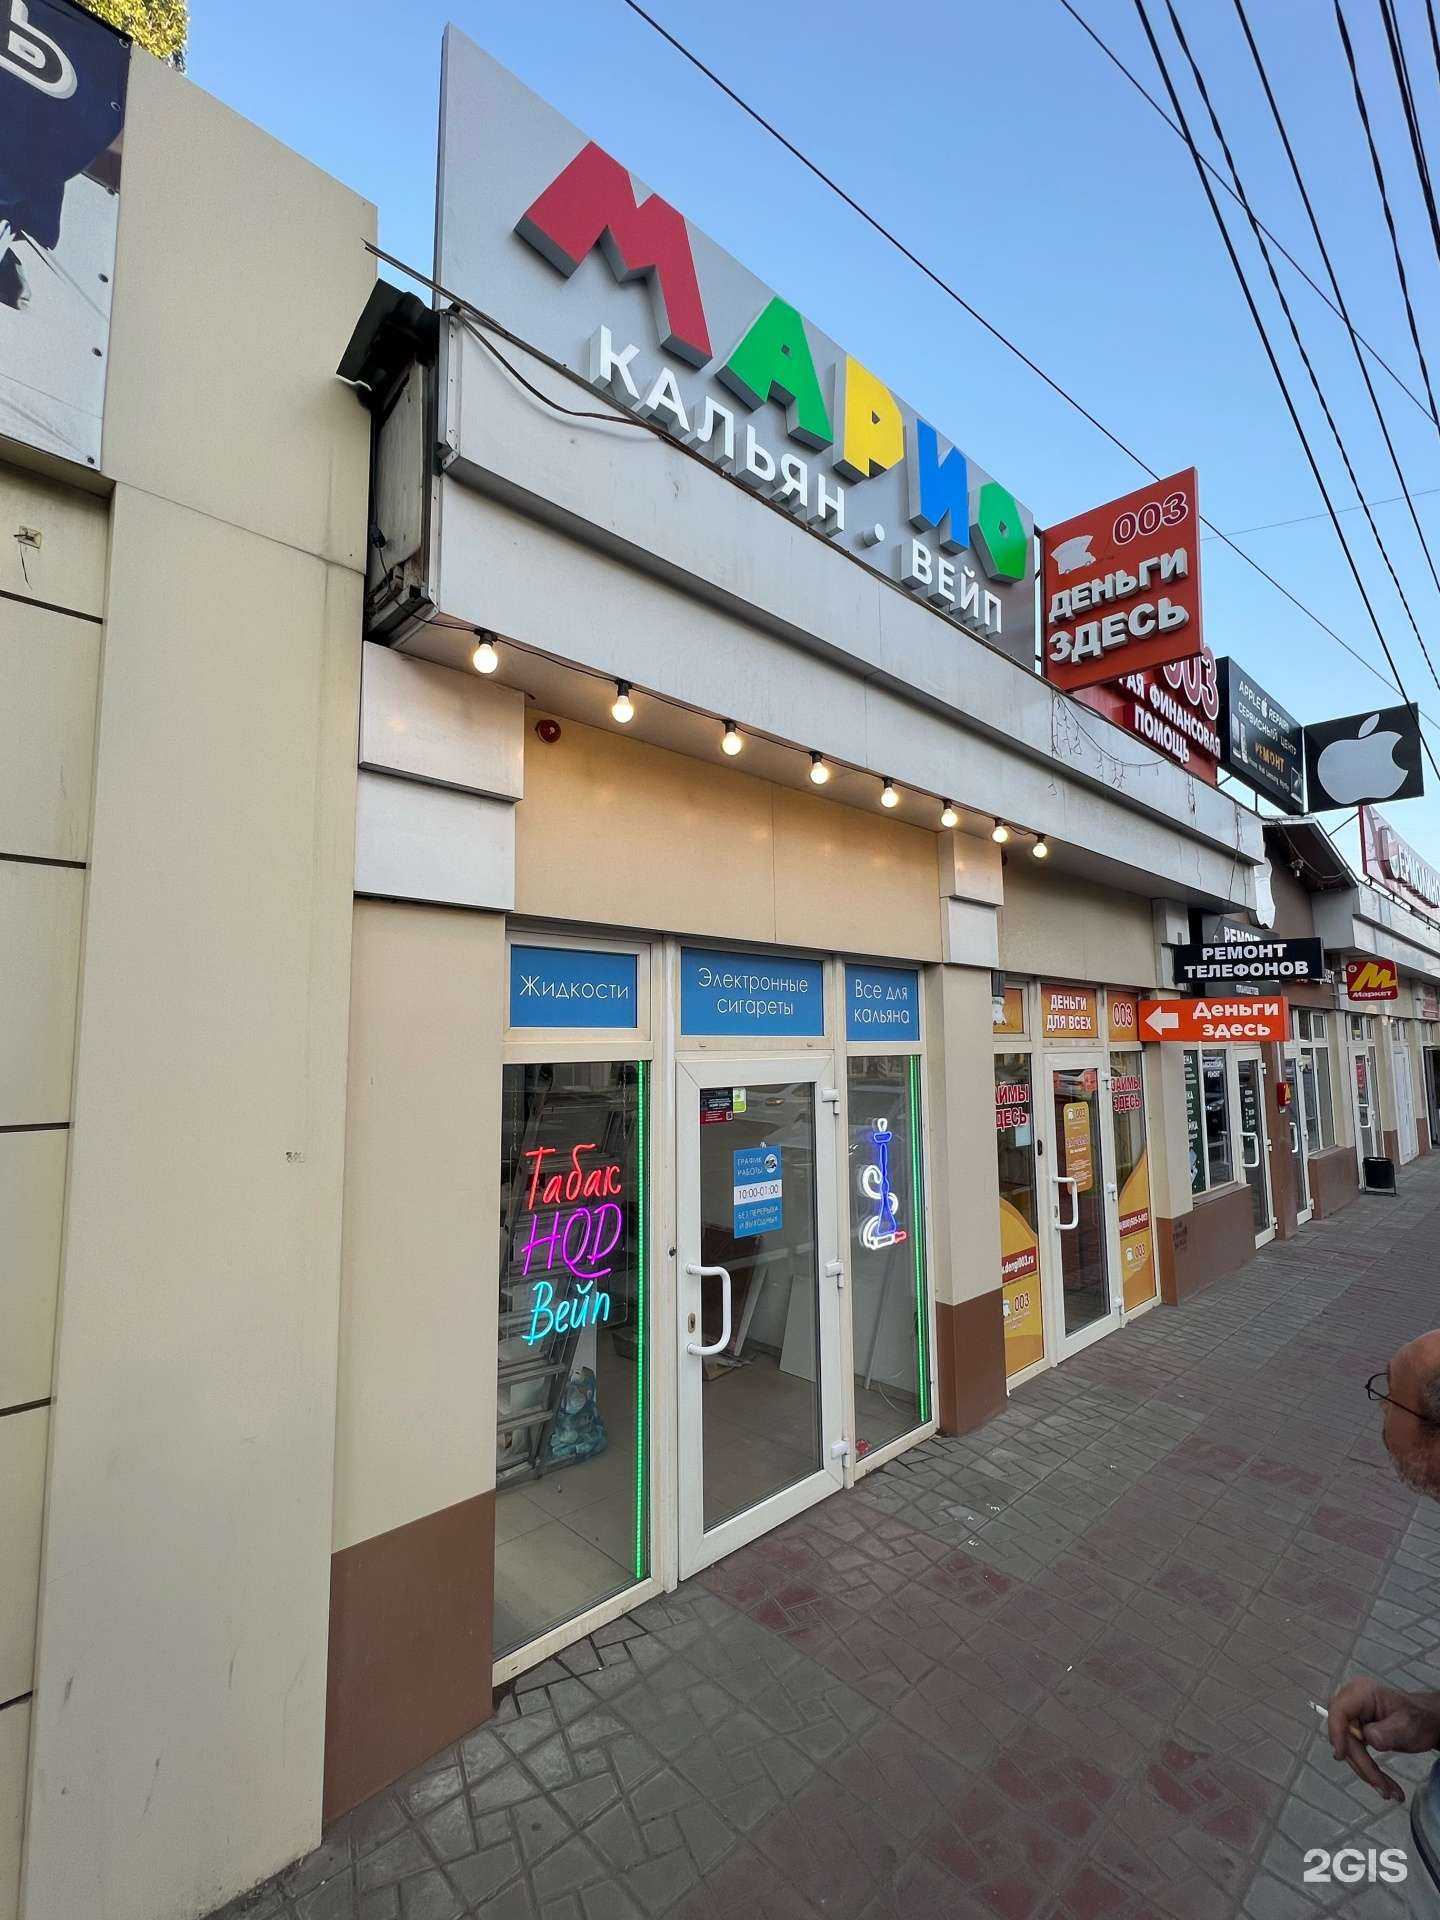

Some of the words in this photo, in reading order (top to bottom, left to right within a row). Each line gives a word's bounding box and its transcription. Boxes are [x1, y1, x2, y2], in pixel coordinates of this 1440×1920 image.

[514, 140, 1028, 583] МАРИО
[590, 324, 846, 537] КАЛЬЯН
[902, 538, 1002, 637] ВЕЙП
[1112, 491, 1189, 546] 003
[1048, 547, 1188, 624] ДЕНЬГИ
[1048, 597, 1190, 665] ЗДЕСЬ
[1238, 680, 1262, 709] APPLE
[1149, 682, 1221, 760] ФИНАНСОВАЯ
[1134, 703, 1190, 763] ПОМОЩЬ
[1201, 943, 1288, 960] РЕМОНТ
[697, 967, 809, 994] Электронные
[1183, 960, 1309, 979] ТЕЛЕФОНОВ
[519, 973, 630, 1000] Жидкости
[854, 979, 883, 1000] Все
[885, 985, 908, 1002] для
[716, 997, 794, 1019] сигареты
[1050, 994, 1087, 1011] ДЕНЬГИ
[1192, 1001, 1280, 1020] Деньги
[853, 1006, 910, 1025] кальяна
[1046, 1014, 1069, 1032] ДЛЯ
[1069, 1015, 1092, 1031] ВСЕХ
[1112, 1002, 1134, 1028] 003
[1202, 1023, 1271, 1039] здесь
[995, 1081, 1031, 1105] ЙМЫ
[1110, 1073, 1142, 1093] ЗАЙМЫ
[1112, 1094, 1142, 1114] ЗДЕСЬ
[995, 1106, 1029, 1129] ДЕСЬ
[737, 1157, 762, 1167] ГРАФИК
[737, 1167, 763, 1177] РАБОТЫ
[524, 1143, 622, 1211] Табак
[738, 1184, 779, 1199] 10:00-01:00
[520, 1202, 625, 1279] HQD
[521, 1280, 611, 1346] Вейп
[1014, 1291, 1030, 1312] 003
